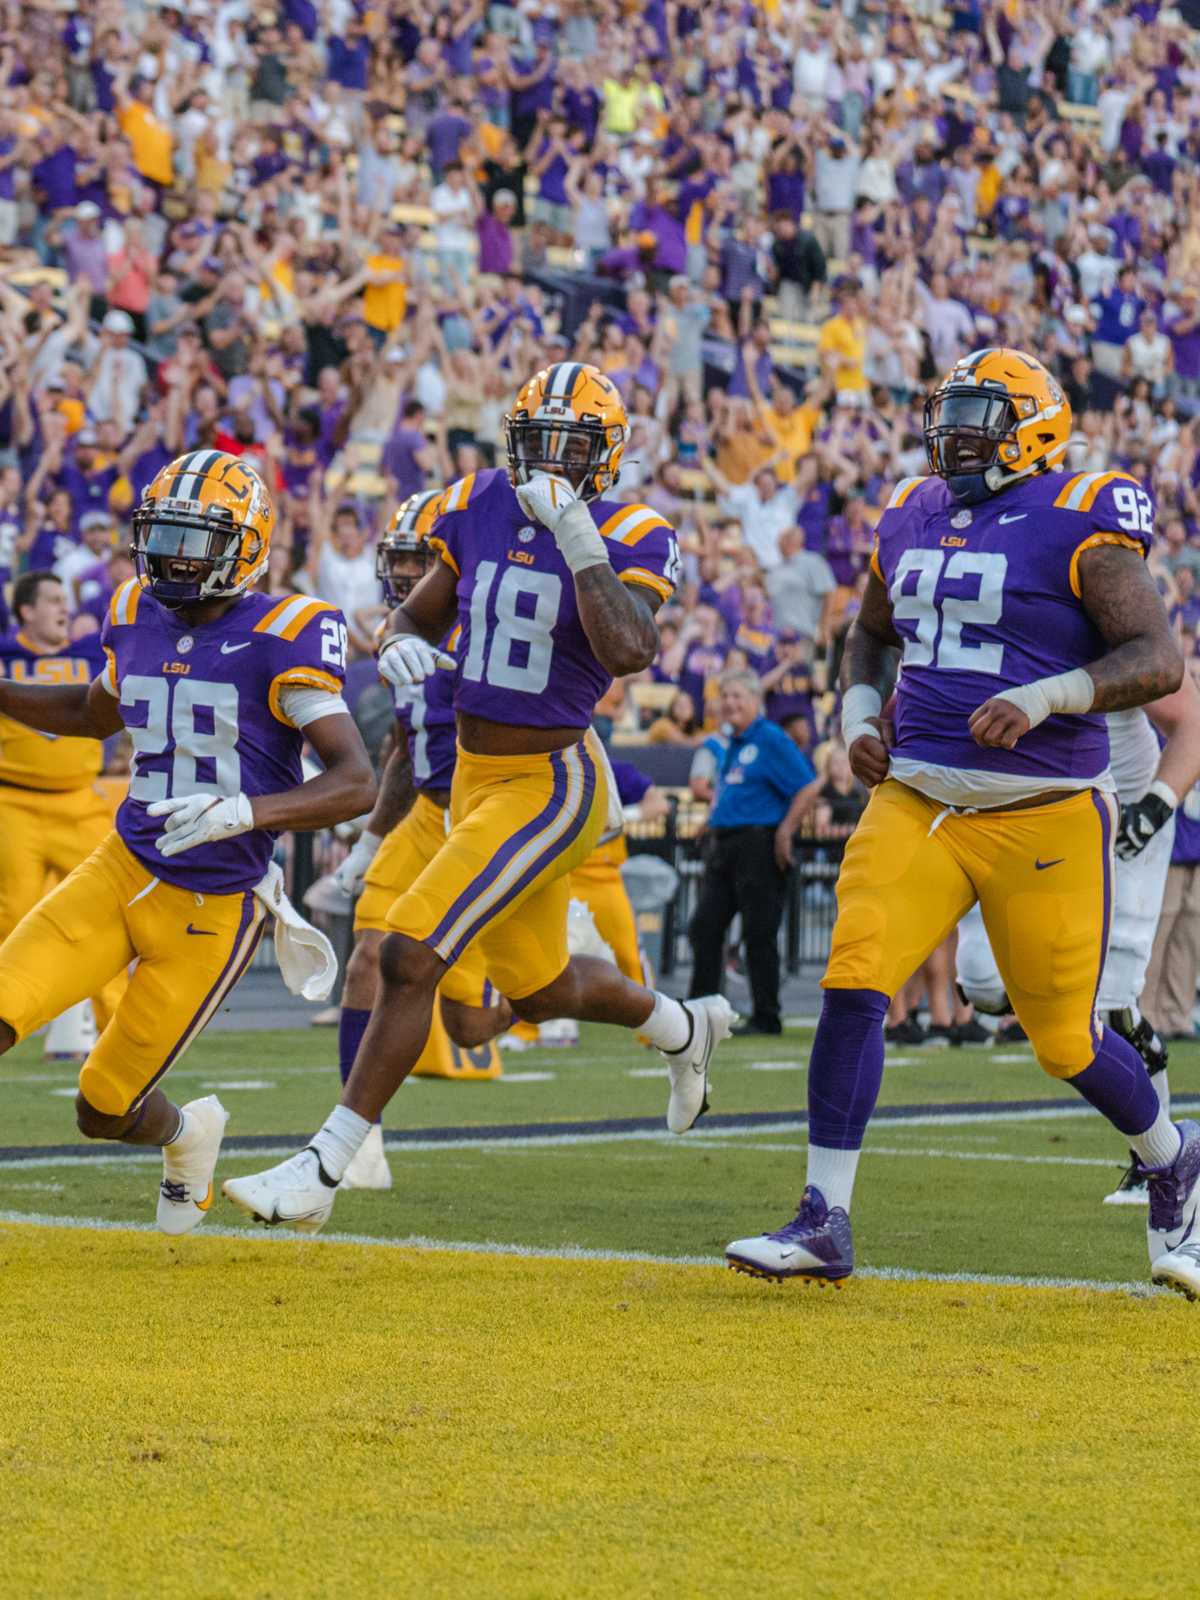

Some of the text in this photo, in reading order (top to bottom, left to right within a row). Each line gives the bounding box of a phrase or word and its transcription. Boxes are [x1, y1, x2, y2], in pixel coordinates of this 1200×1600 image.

[543, 405, 566, 416] LSU
[1112, 487, 1154, 534] 92
[508, 549, 535, 565] LSU
[940, 536, 968, 548] LSU
[462, 560, 563, 694] 18
[890, 548, 1009, 675] 92
[9, 659, 90, 686] LSU
[162, 662, 191, 674] LSU
[119, 674, 241, 804] 28
[394, 682, 432, 781] 7
